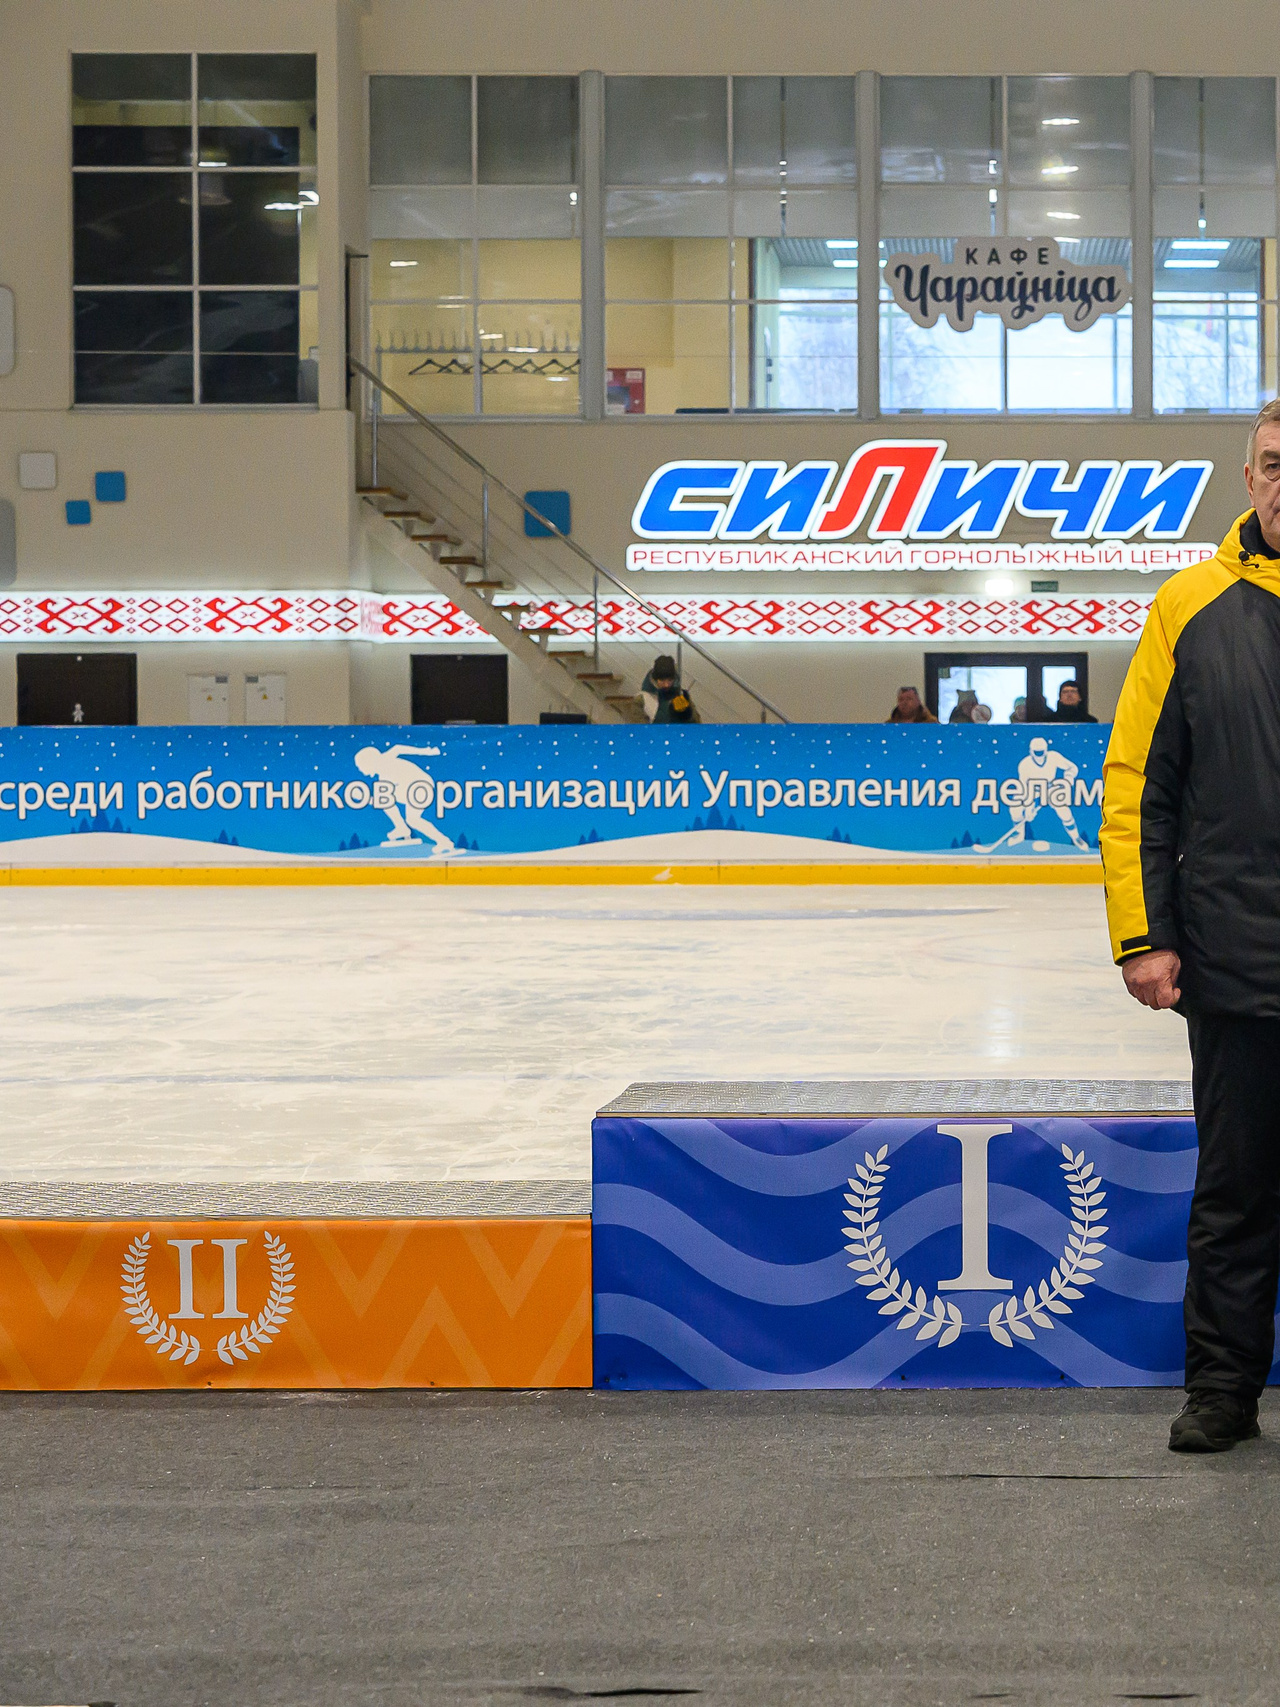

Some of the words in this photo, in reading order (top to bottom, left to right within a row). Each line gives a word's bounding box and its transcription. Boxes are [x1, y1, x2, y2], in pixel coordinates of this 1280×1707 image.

[965, 247, 1050, 266] КАФЕ
[893, 263, 1122, 322] Чараўніца
[632, 546, 903, 565] РЕСПУБЛИКАНСКИЙ
[910, 545, 1123, 565] ГОРНОЛЫЖНЫЙ
[1130, 549, 1214, 567] ЦЕНТР
[0, 781, 125, 821] среди
[136, 769, 398, 820] работников
[406, 769, 690, 820] организаций
[699, 769, 962, 818] Управления
[936, 1123, 1014, 1291] I
[166, 1238, 250, 1320] II
